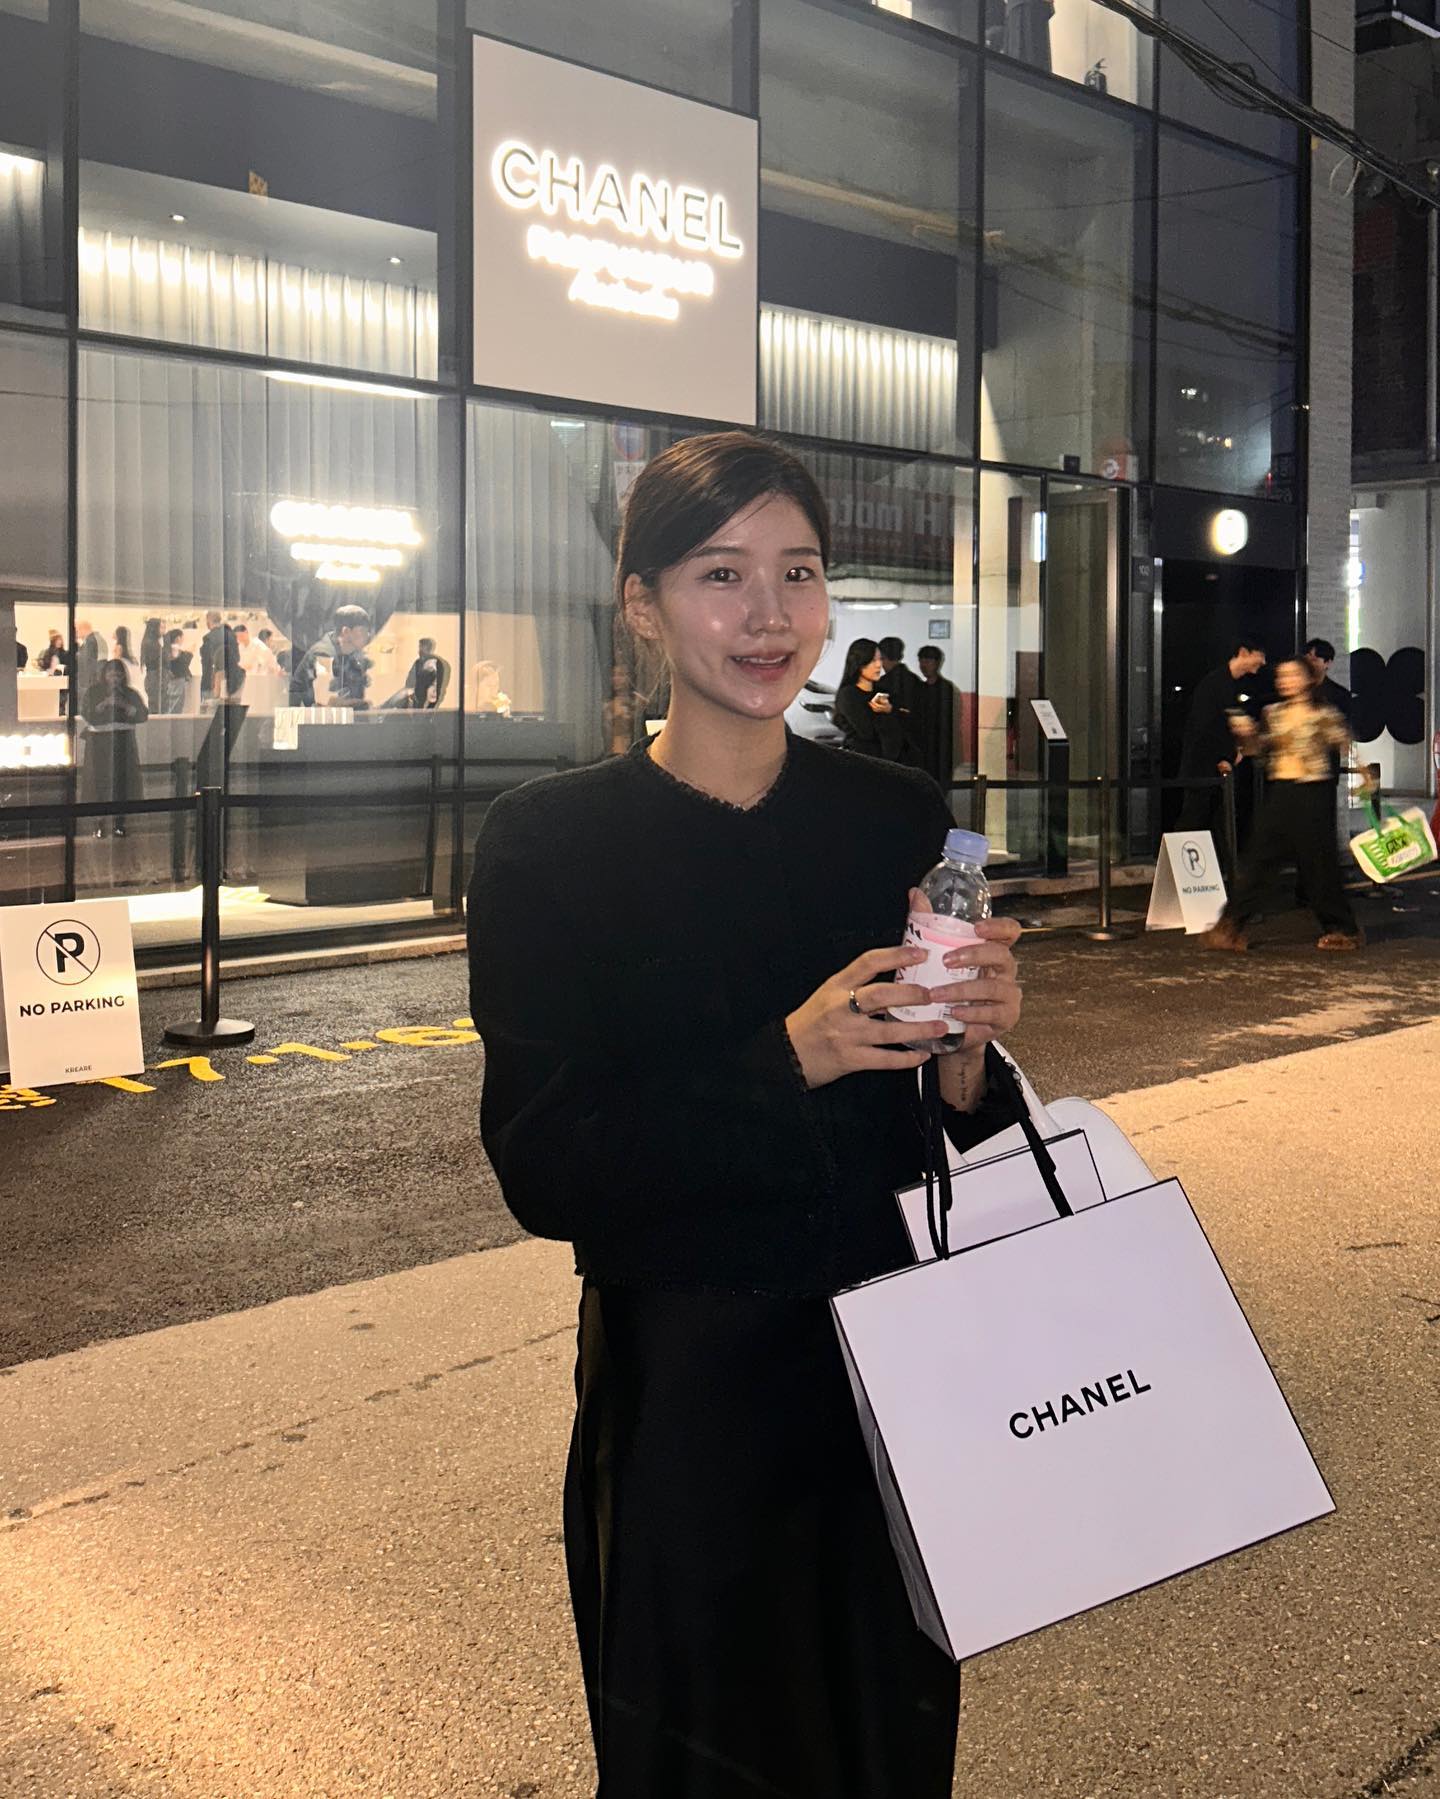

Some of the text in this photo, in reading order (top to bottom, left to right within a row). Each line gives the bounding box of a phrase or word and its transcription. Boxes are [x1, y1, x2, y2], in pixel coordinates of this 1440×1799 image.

[498, 145, 743, 253] CHANEL
[1182, 883, 1220, 895] NO PARKING
[19, 995, 126, 1018] NO PARKING
[64, 1064, 93, 1074] KREARE
[1009, 1369, 1152, 1439] CHANEL
